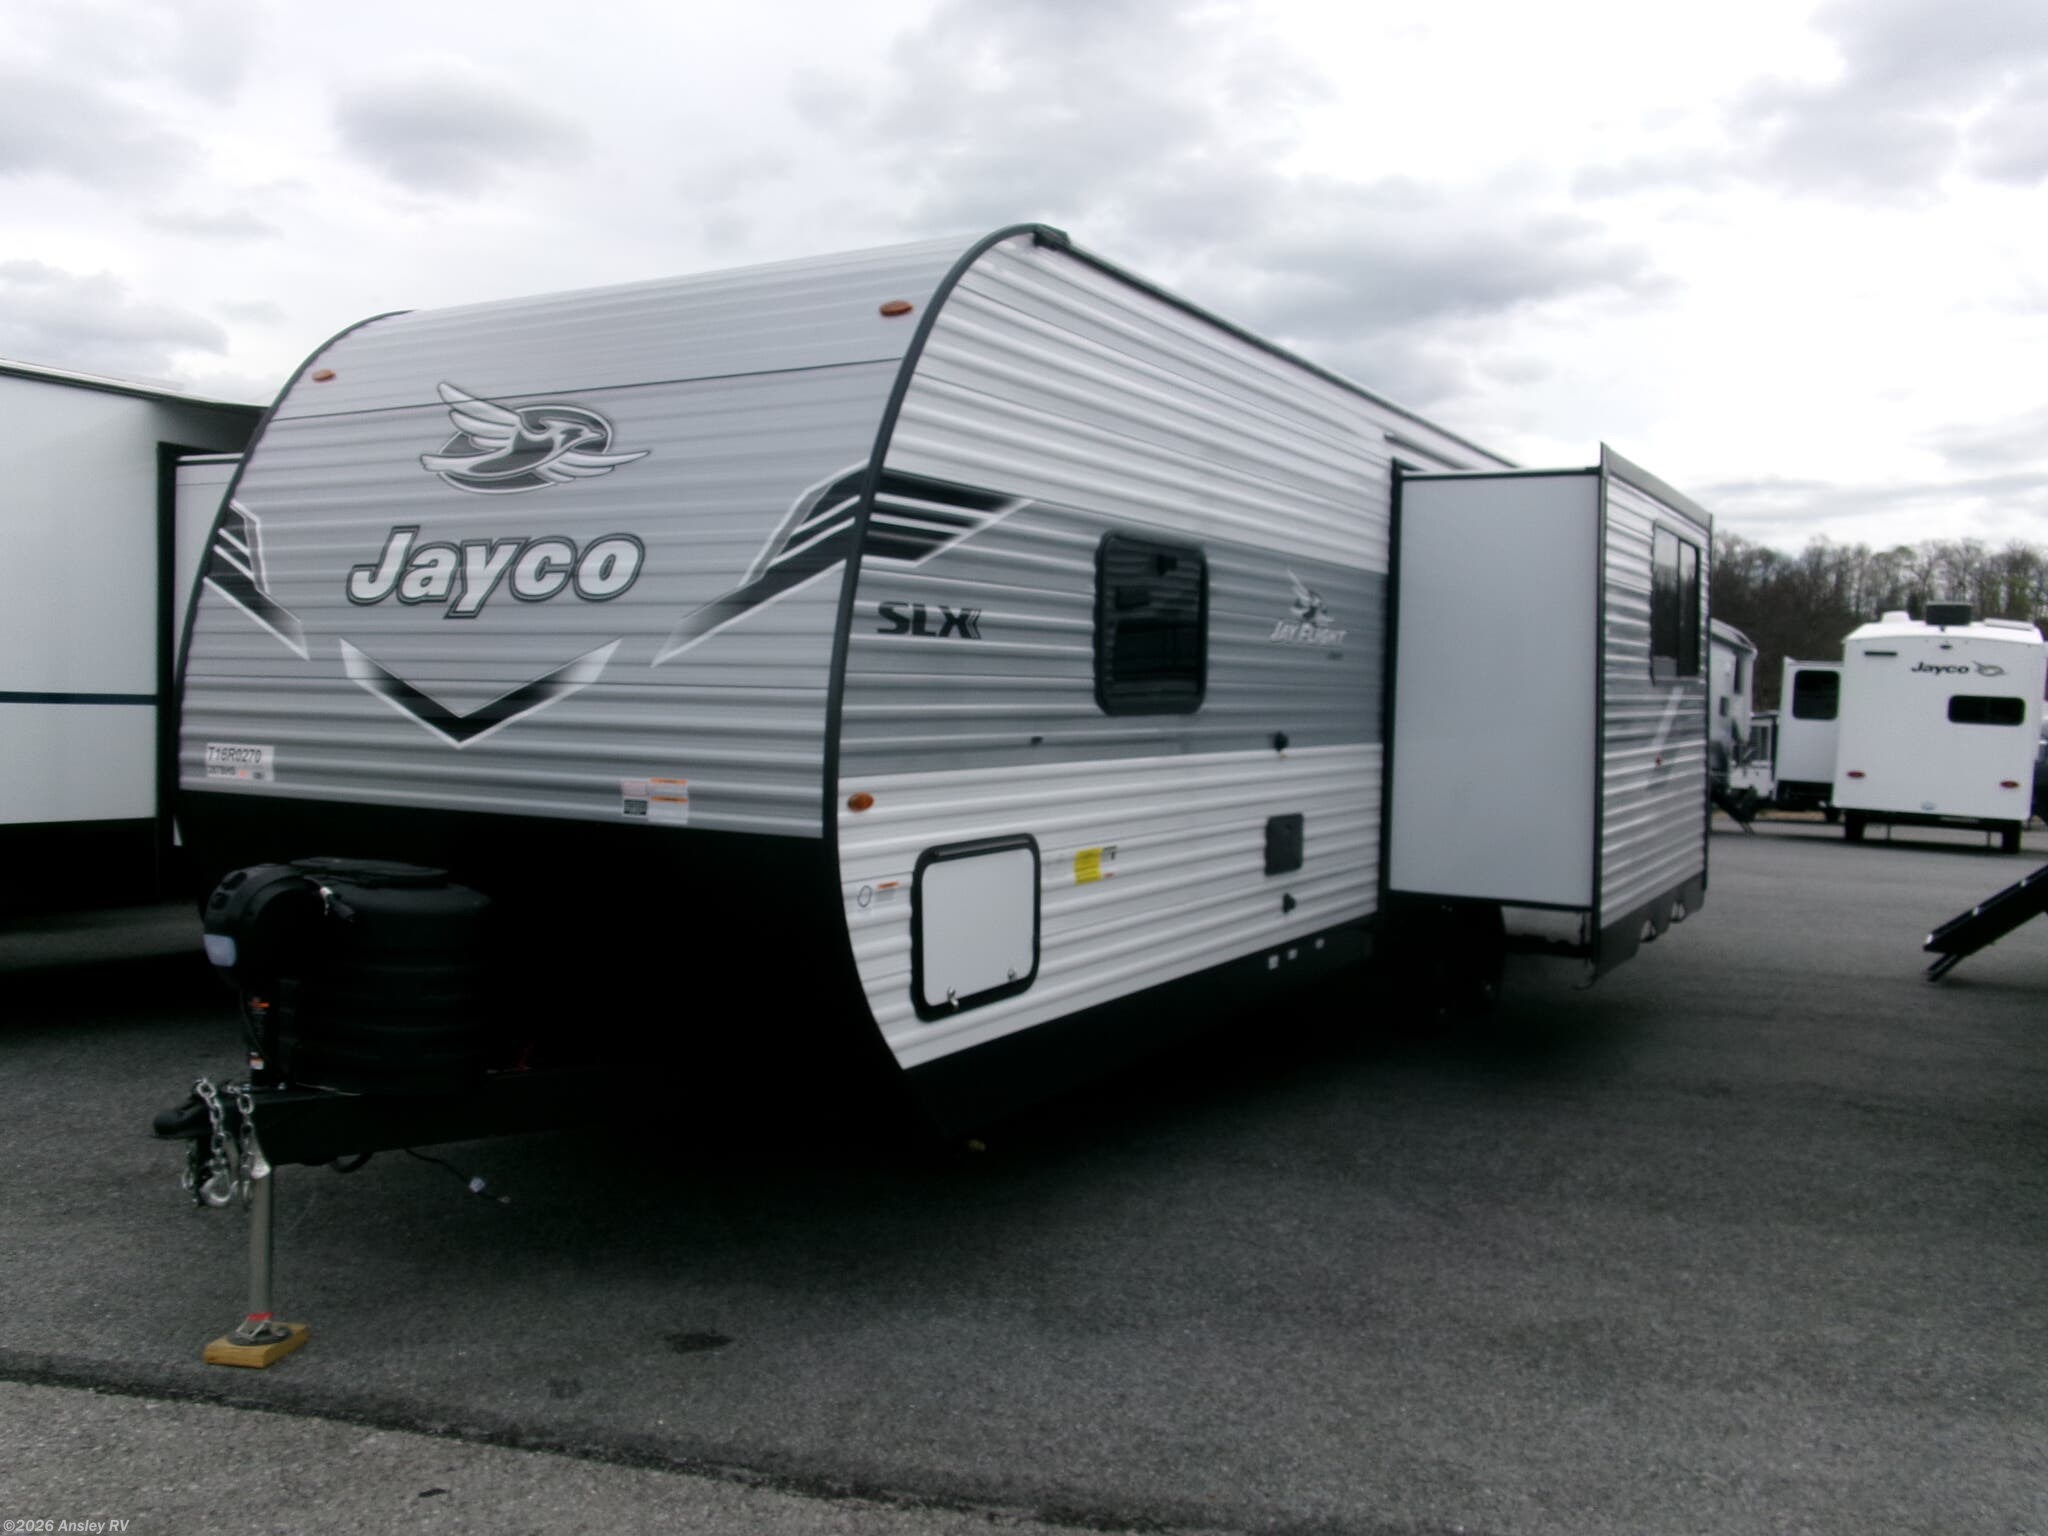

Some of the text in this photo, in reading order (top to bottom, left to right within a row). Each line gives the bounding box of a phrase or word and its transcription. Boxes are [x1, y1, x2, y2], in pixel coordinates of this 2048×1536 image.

[346, 524, 646, 619] Jayco
[877, 602, 982, 640] SLX
[1911, 661, 1970, 676] Jayco
